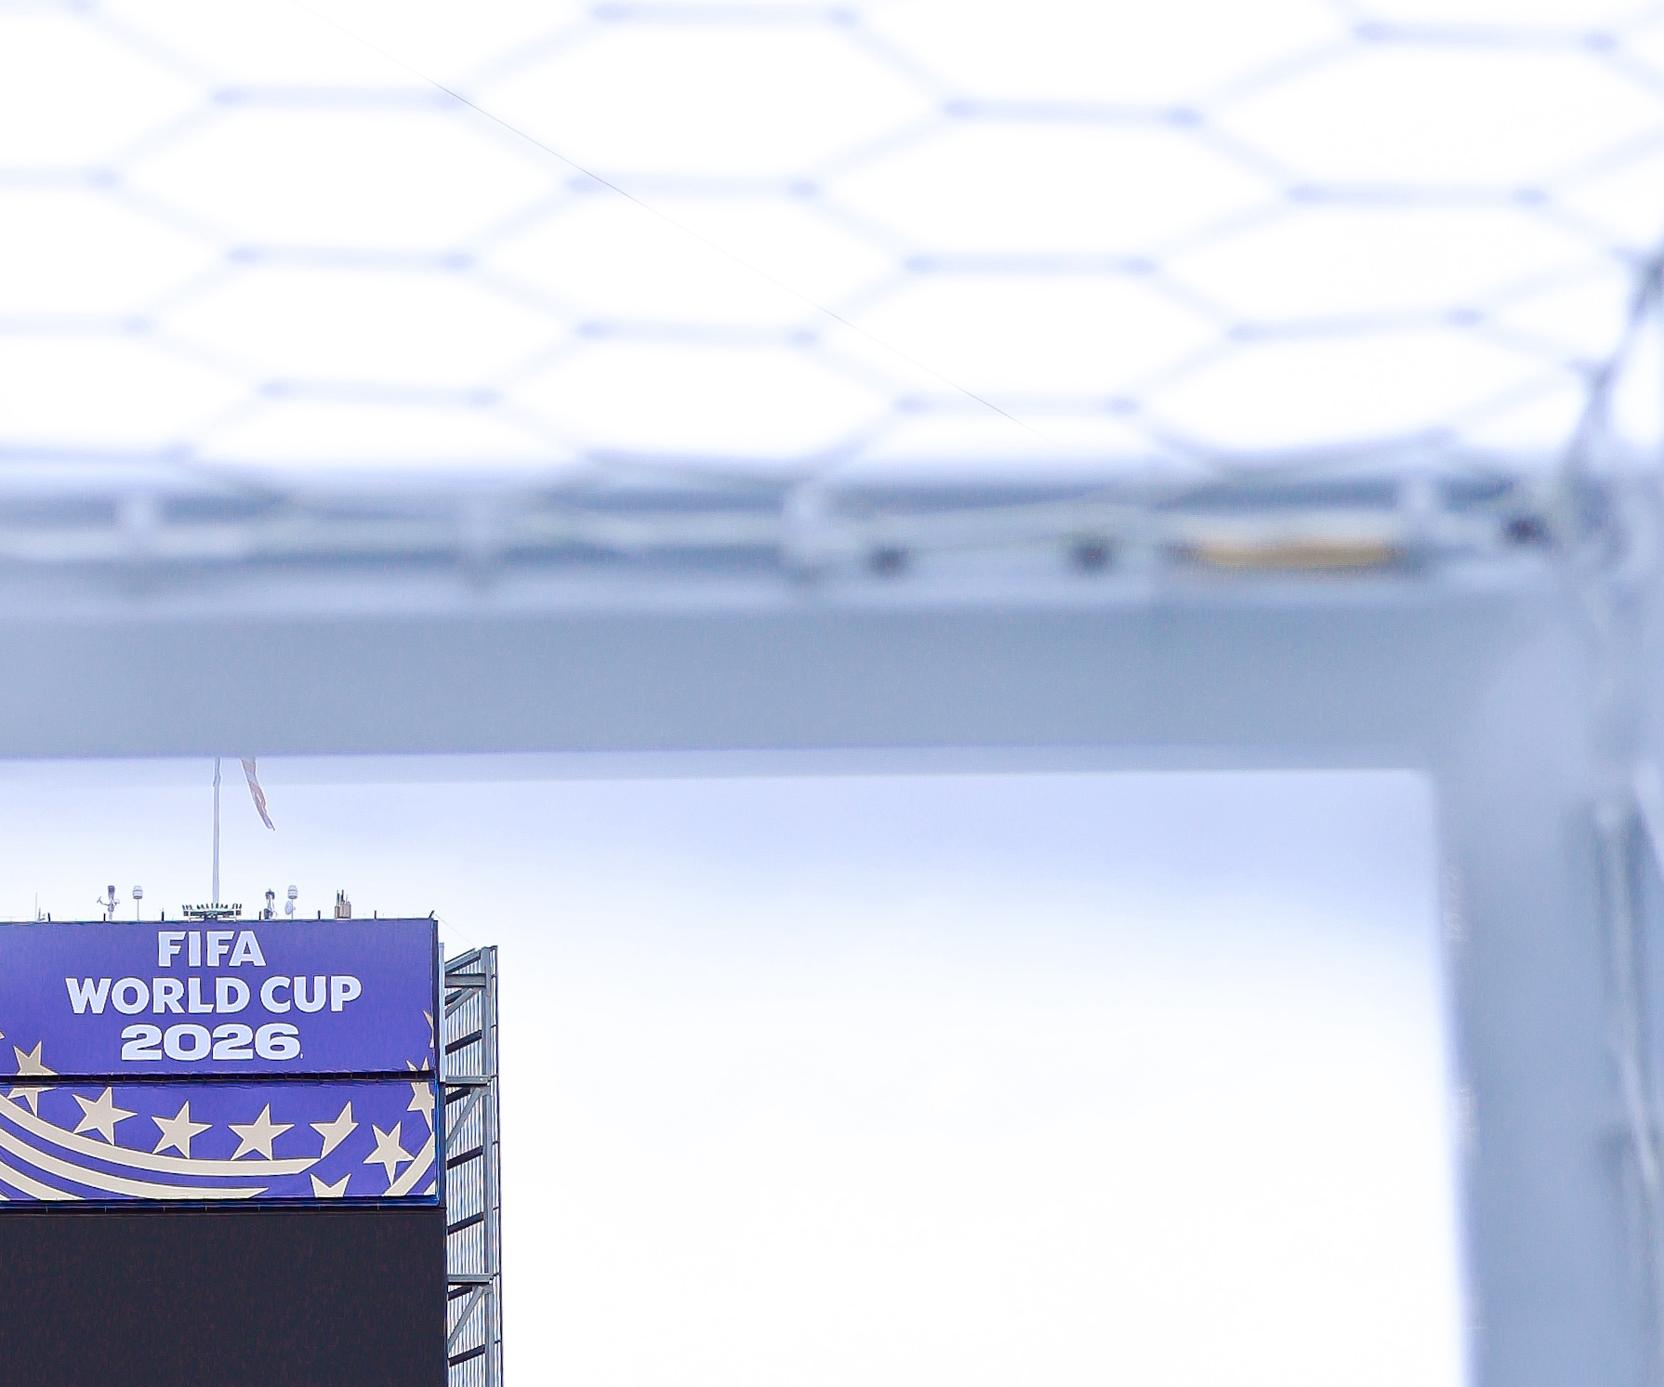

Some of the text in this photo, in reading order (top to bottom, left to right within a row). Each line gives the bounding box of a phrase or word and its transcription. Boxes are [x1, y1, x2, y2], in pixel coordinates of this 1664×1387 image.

[158, 931, 266, 967] FIFA
[65, 975, 362, 1014] WORLD CUP
[121, 1023, 300, 1061] 2026
